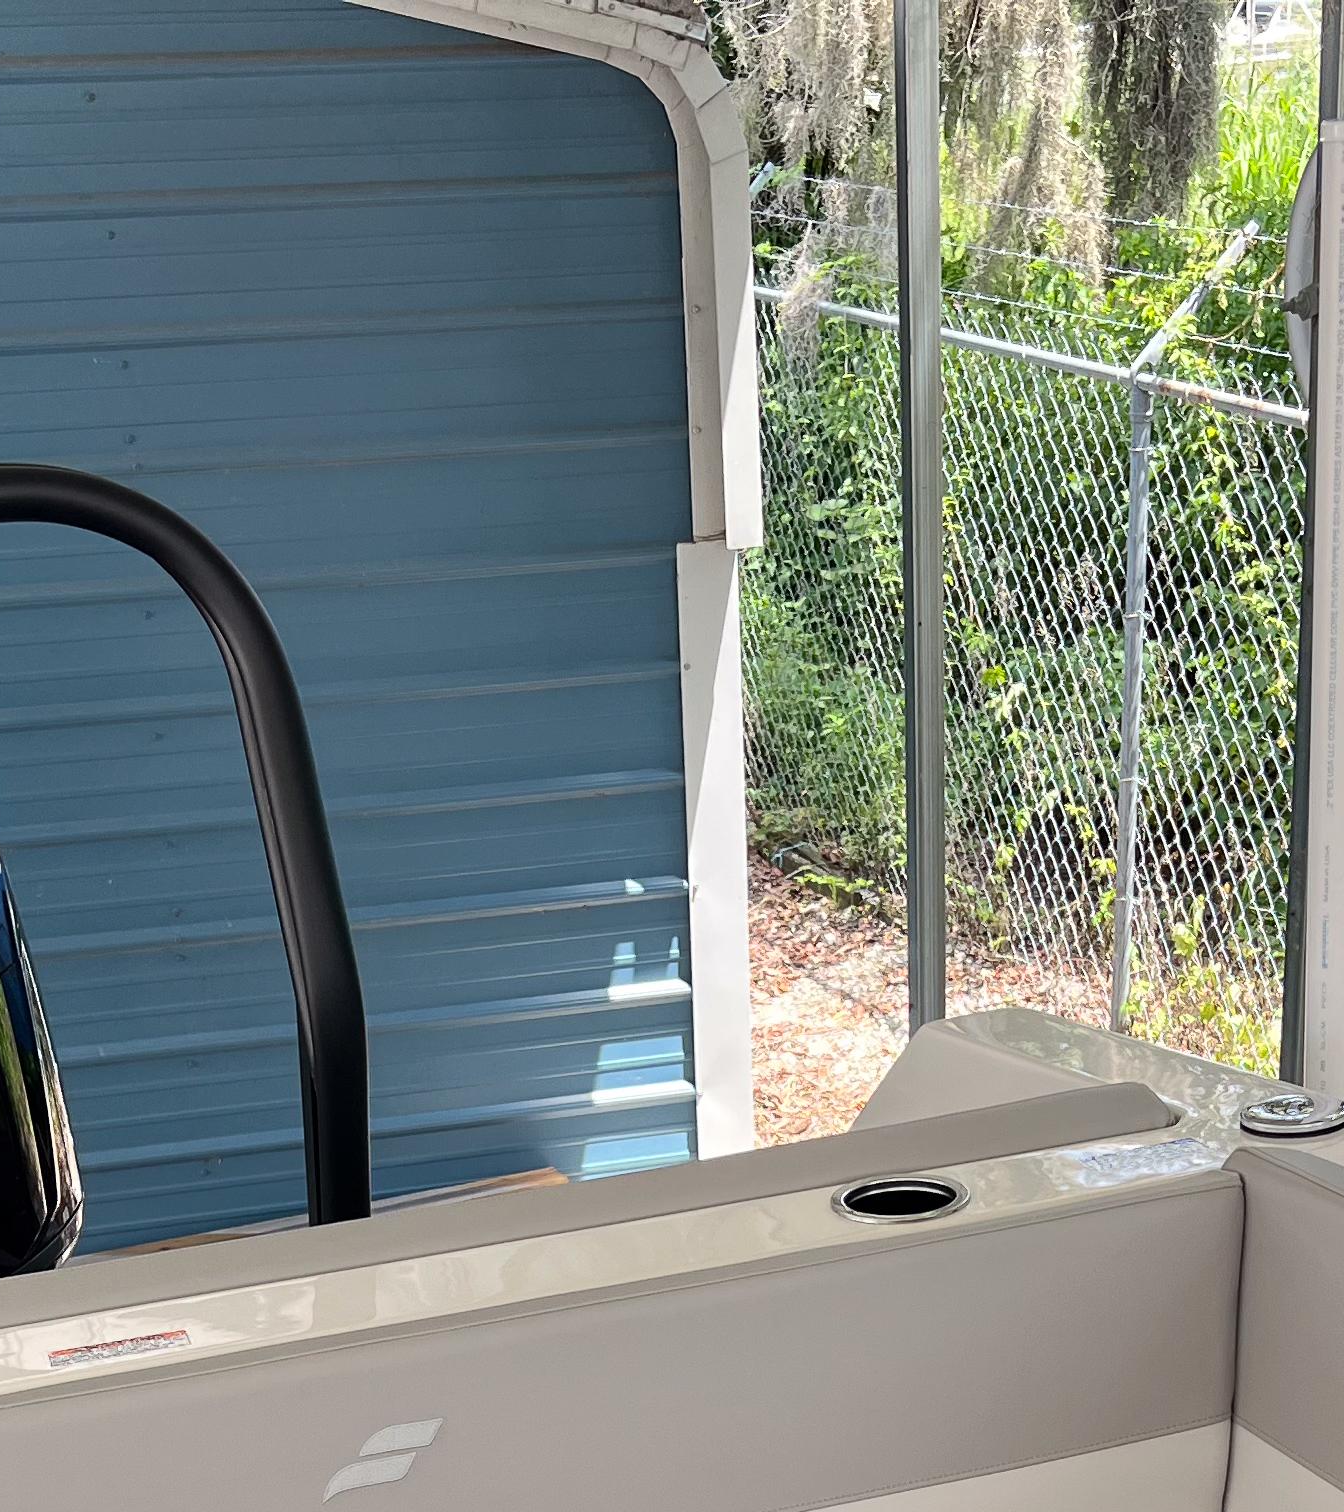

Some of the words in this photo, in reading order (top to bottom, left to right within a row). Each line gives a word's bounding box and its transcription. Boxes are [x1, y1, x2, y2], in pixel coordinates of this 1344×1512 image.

[1334, 431, 1342, 457] ASTM
[1330, 610, 1338, 635] CORE
[1329, 637, 1337, 681] CELLULAR
[1327, 743, 1335, 758] LLC
